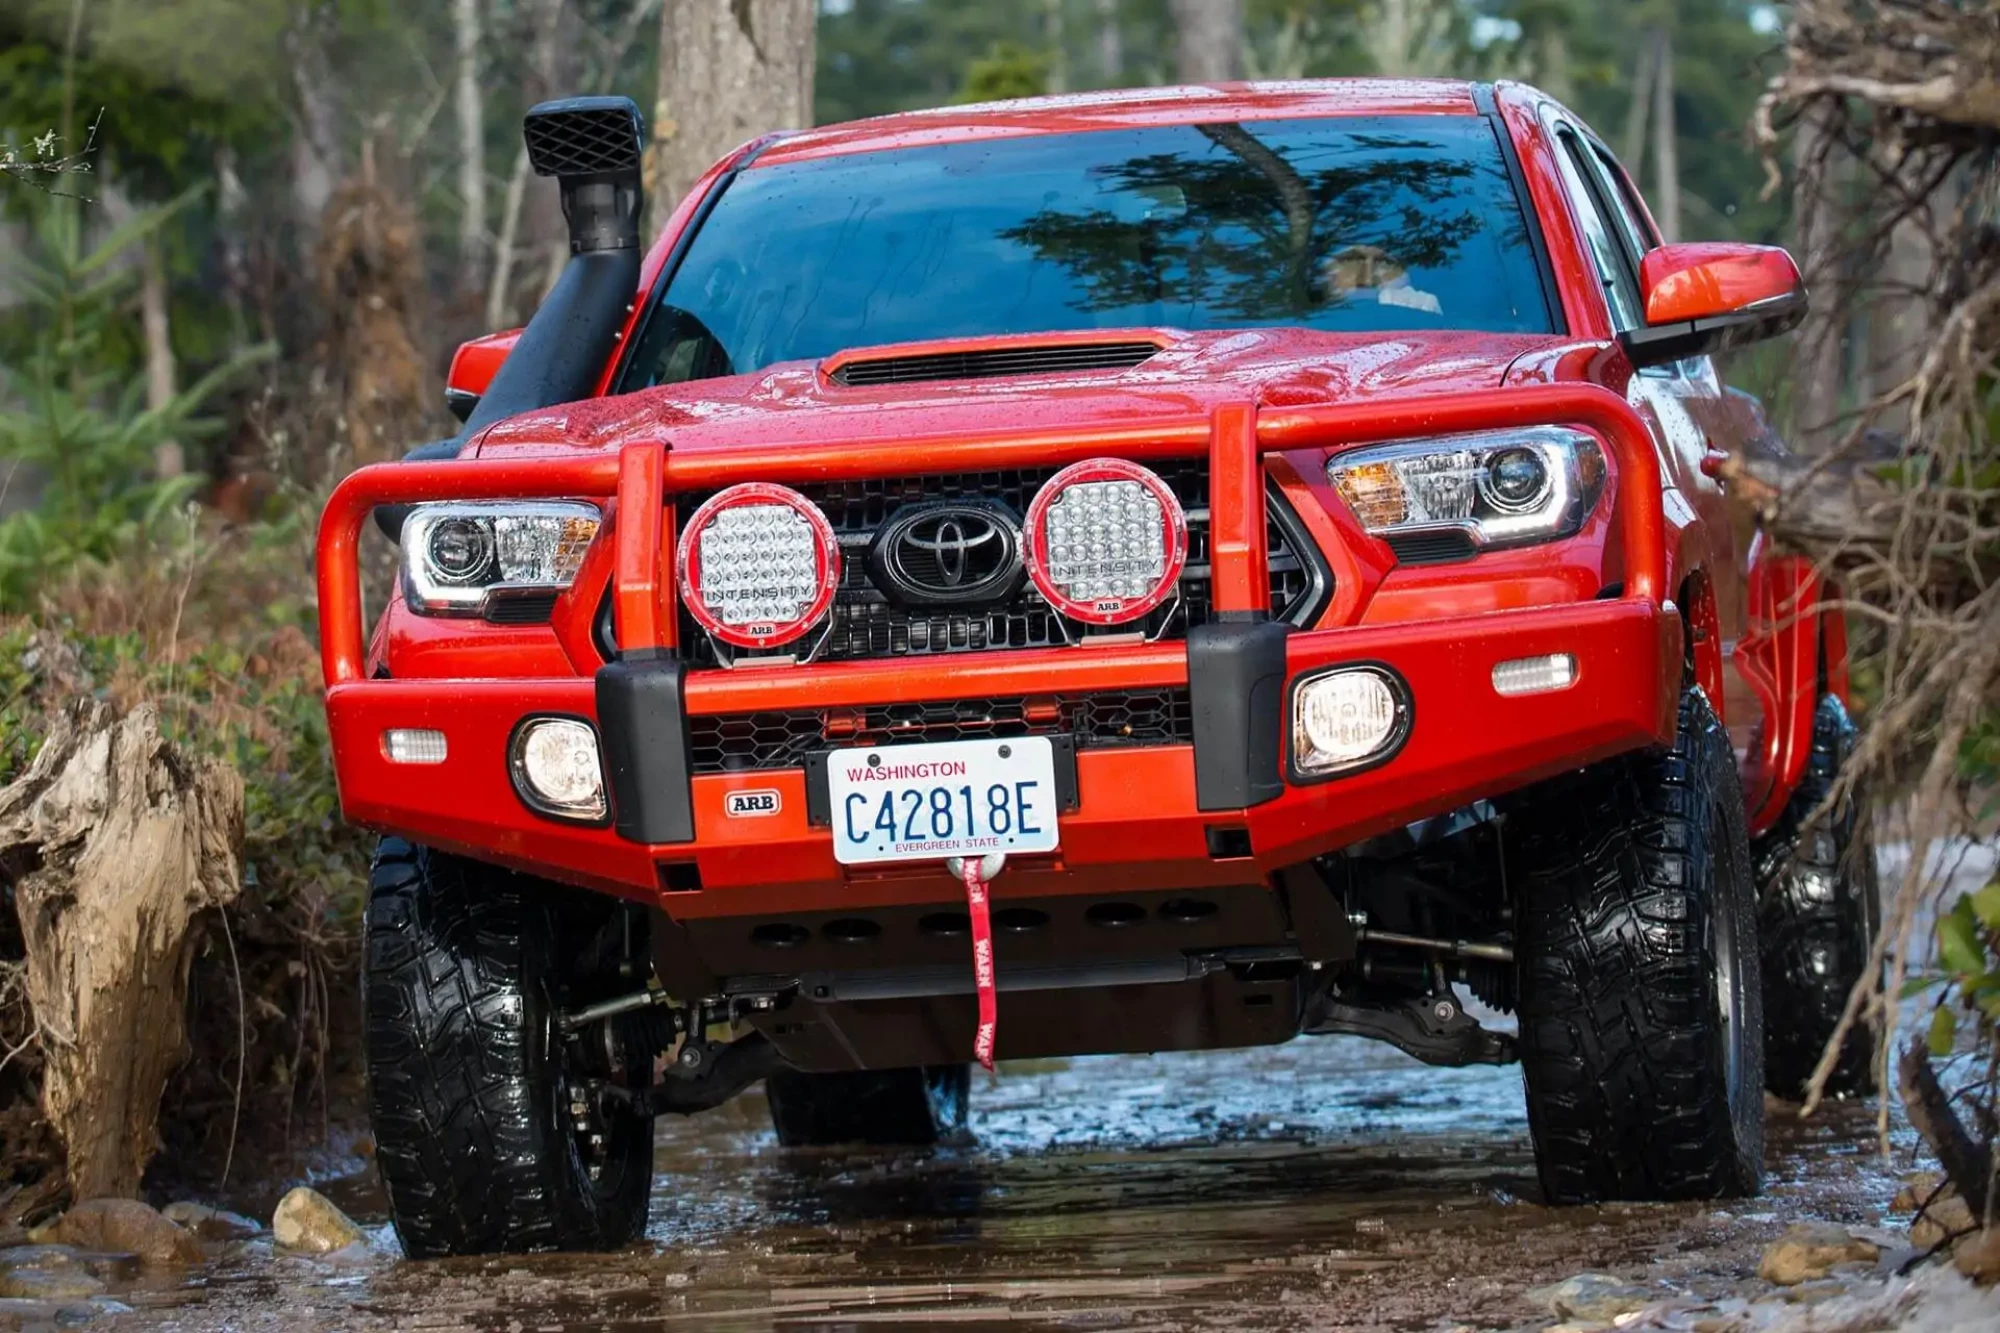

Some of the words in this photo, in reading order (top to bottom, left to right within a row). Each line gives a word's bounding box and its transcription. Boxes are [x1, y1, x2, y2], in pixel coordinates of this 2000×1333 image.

[1053, 560, 1159, 577] INTENSITY
[706, 586, 811, 601] INTENSITY
[1097, 602, 1120, 611] ARB
[751, 626, 773, 635] ARB
[847, 761, 967, 782] WASHINGTON
[733, 795, 775, 811] ARB
[845, 781, 1041, 843] C42818E
[895, 839, 961, 853] EVERGREEN
[966, 837, 1000, 849] STATE
[976, 938, 992, 988] WARN
